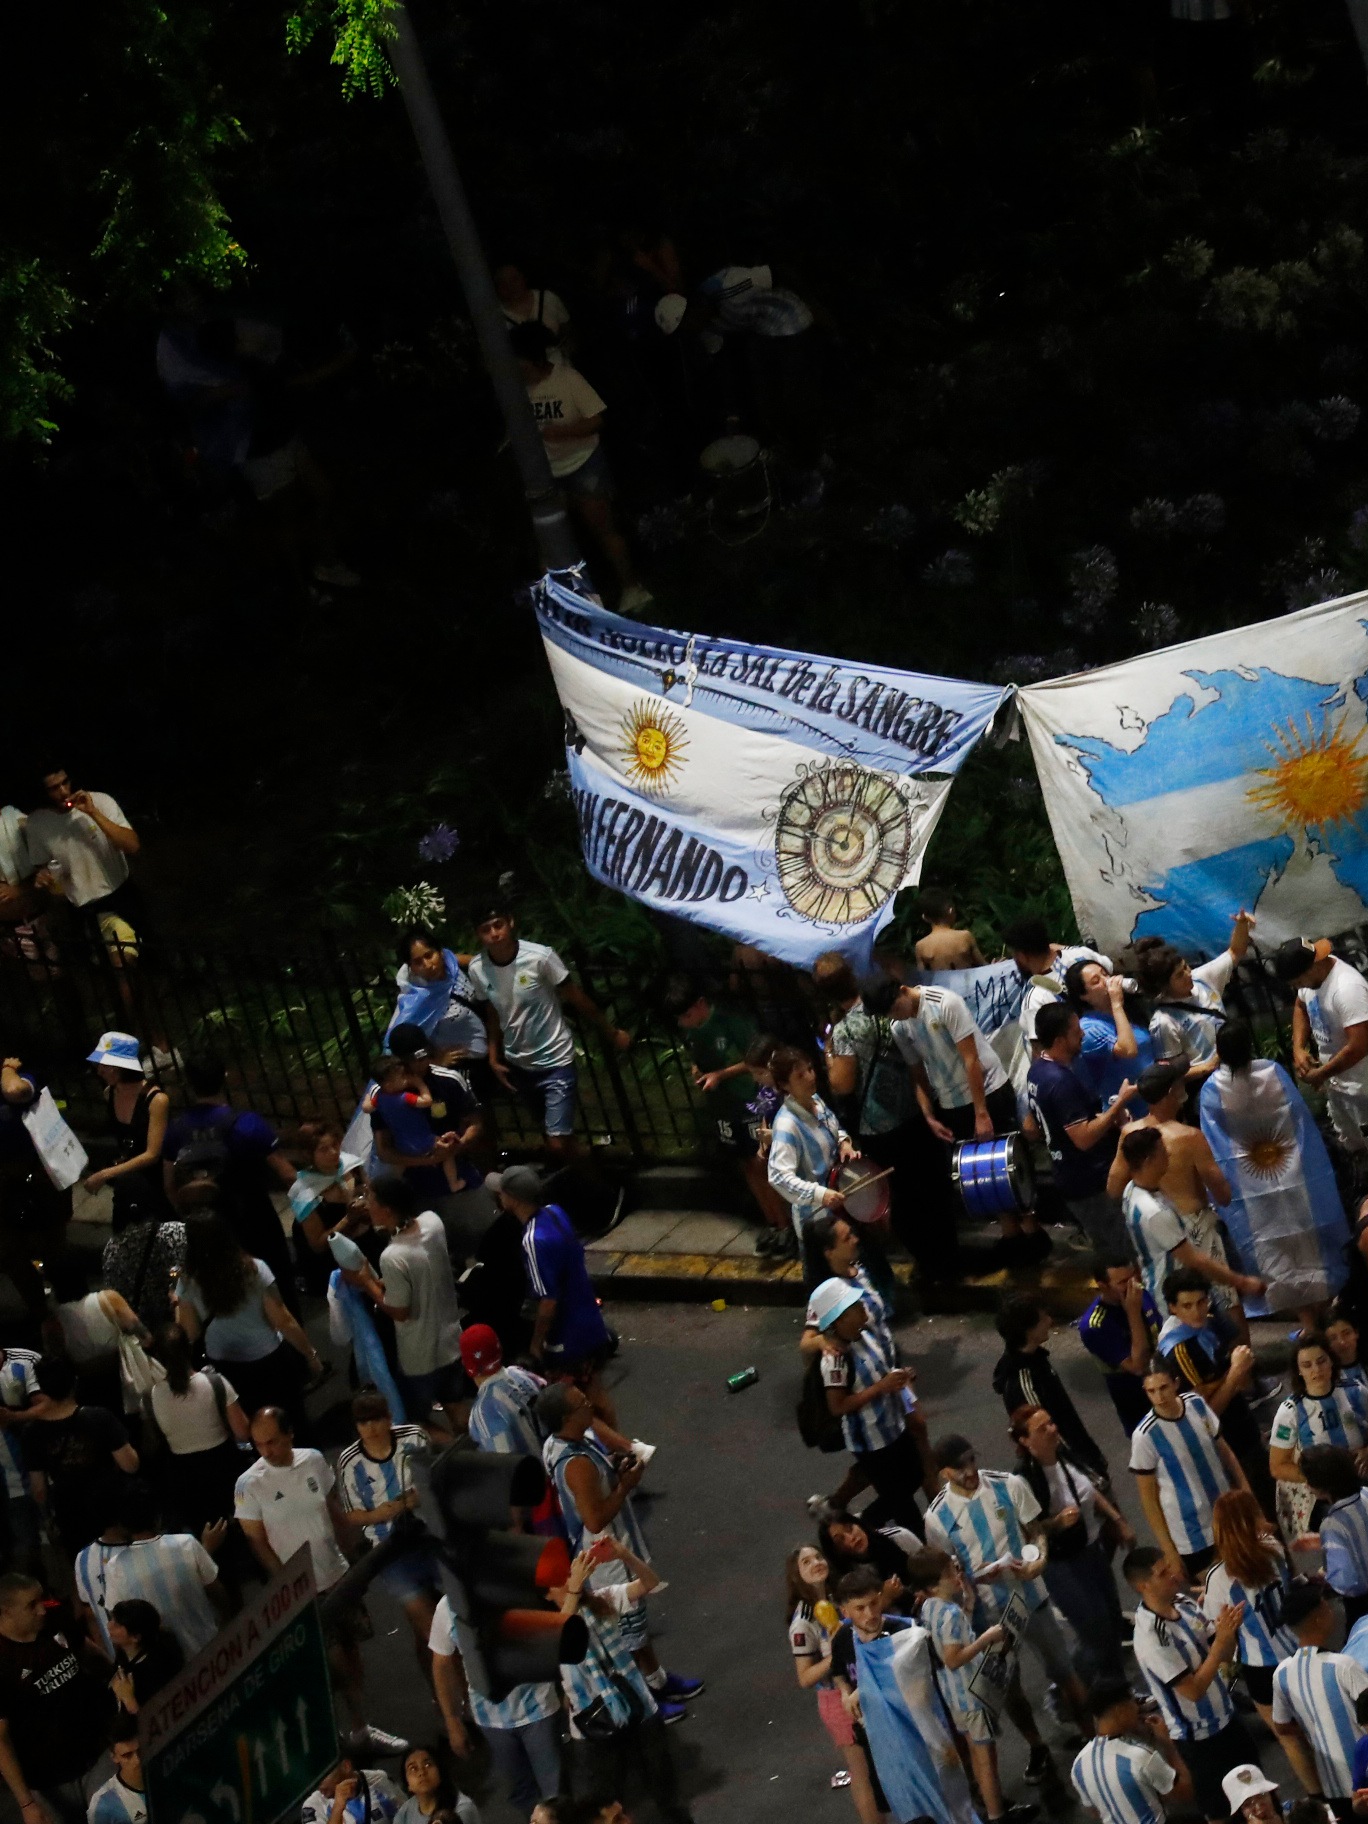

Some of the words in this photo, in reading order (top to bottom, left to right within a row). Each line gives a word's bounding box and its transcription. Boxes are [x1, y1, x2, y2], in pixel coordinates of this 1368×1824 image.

[528, 400, 564, 420] EAK
[836, 674, 965, 757] SANGRE
[599, 797, 749, 903] FERNANDO
[33, 1652, 77, 1690] TURKISH
[148, 1635, 243, 1739] ATENCION
[247, 1619, 261, 1643] A
[241, 1666, 266, 1698] DE
[268, 1624, 306, 1674] GIRO
